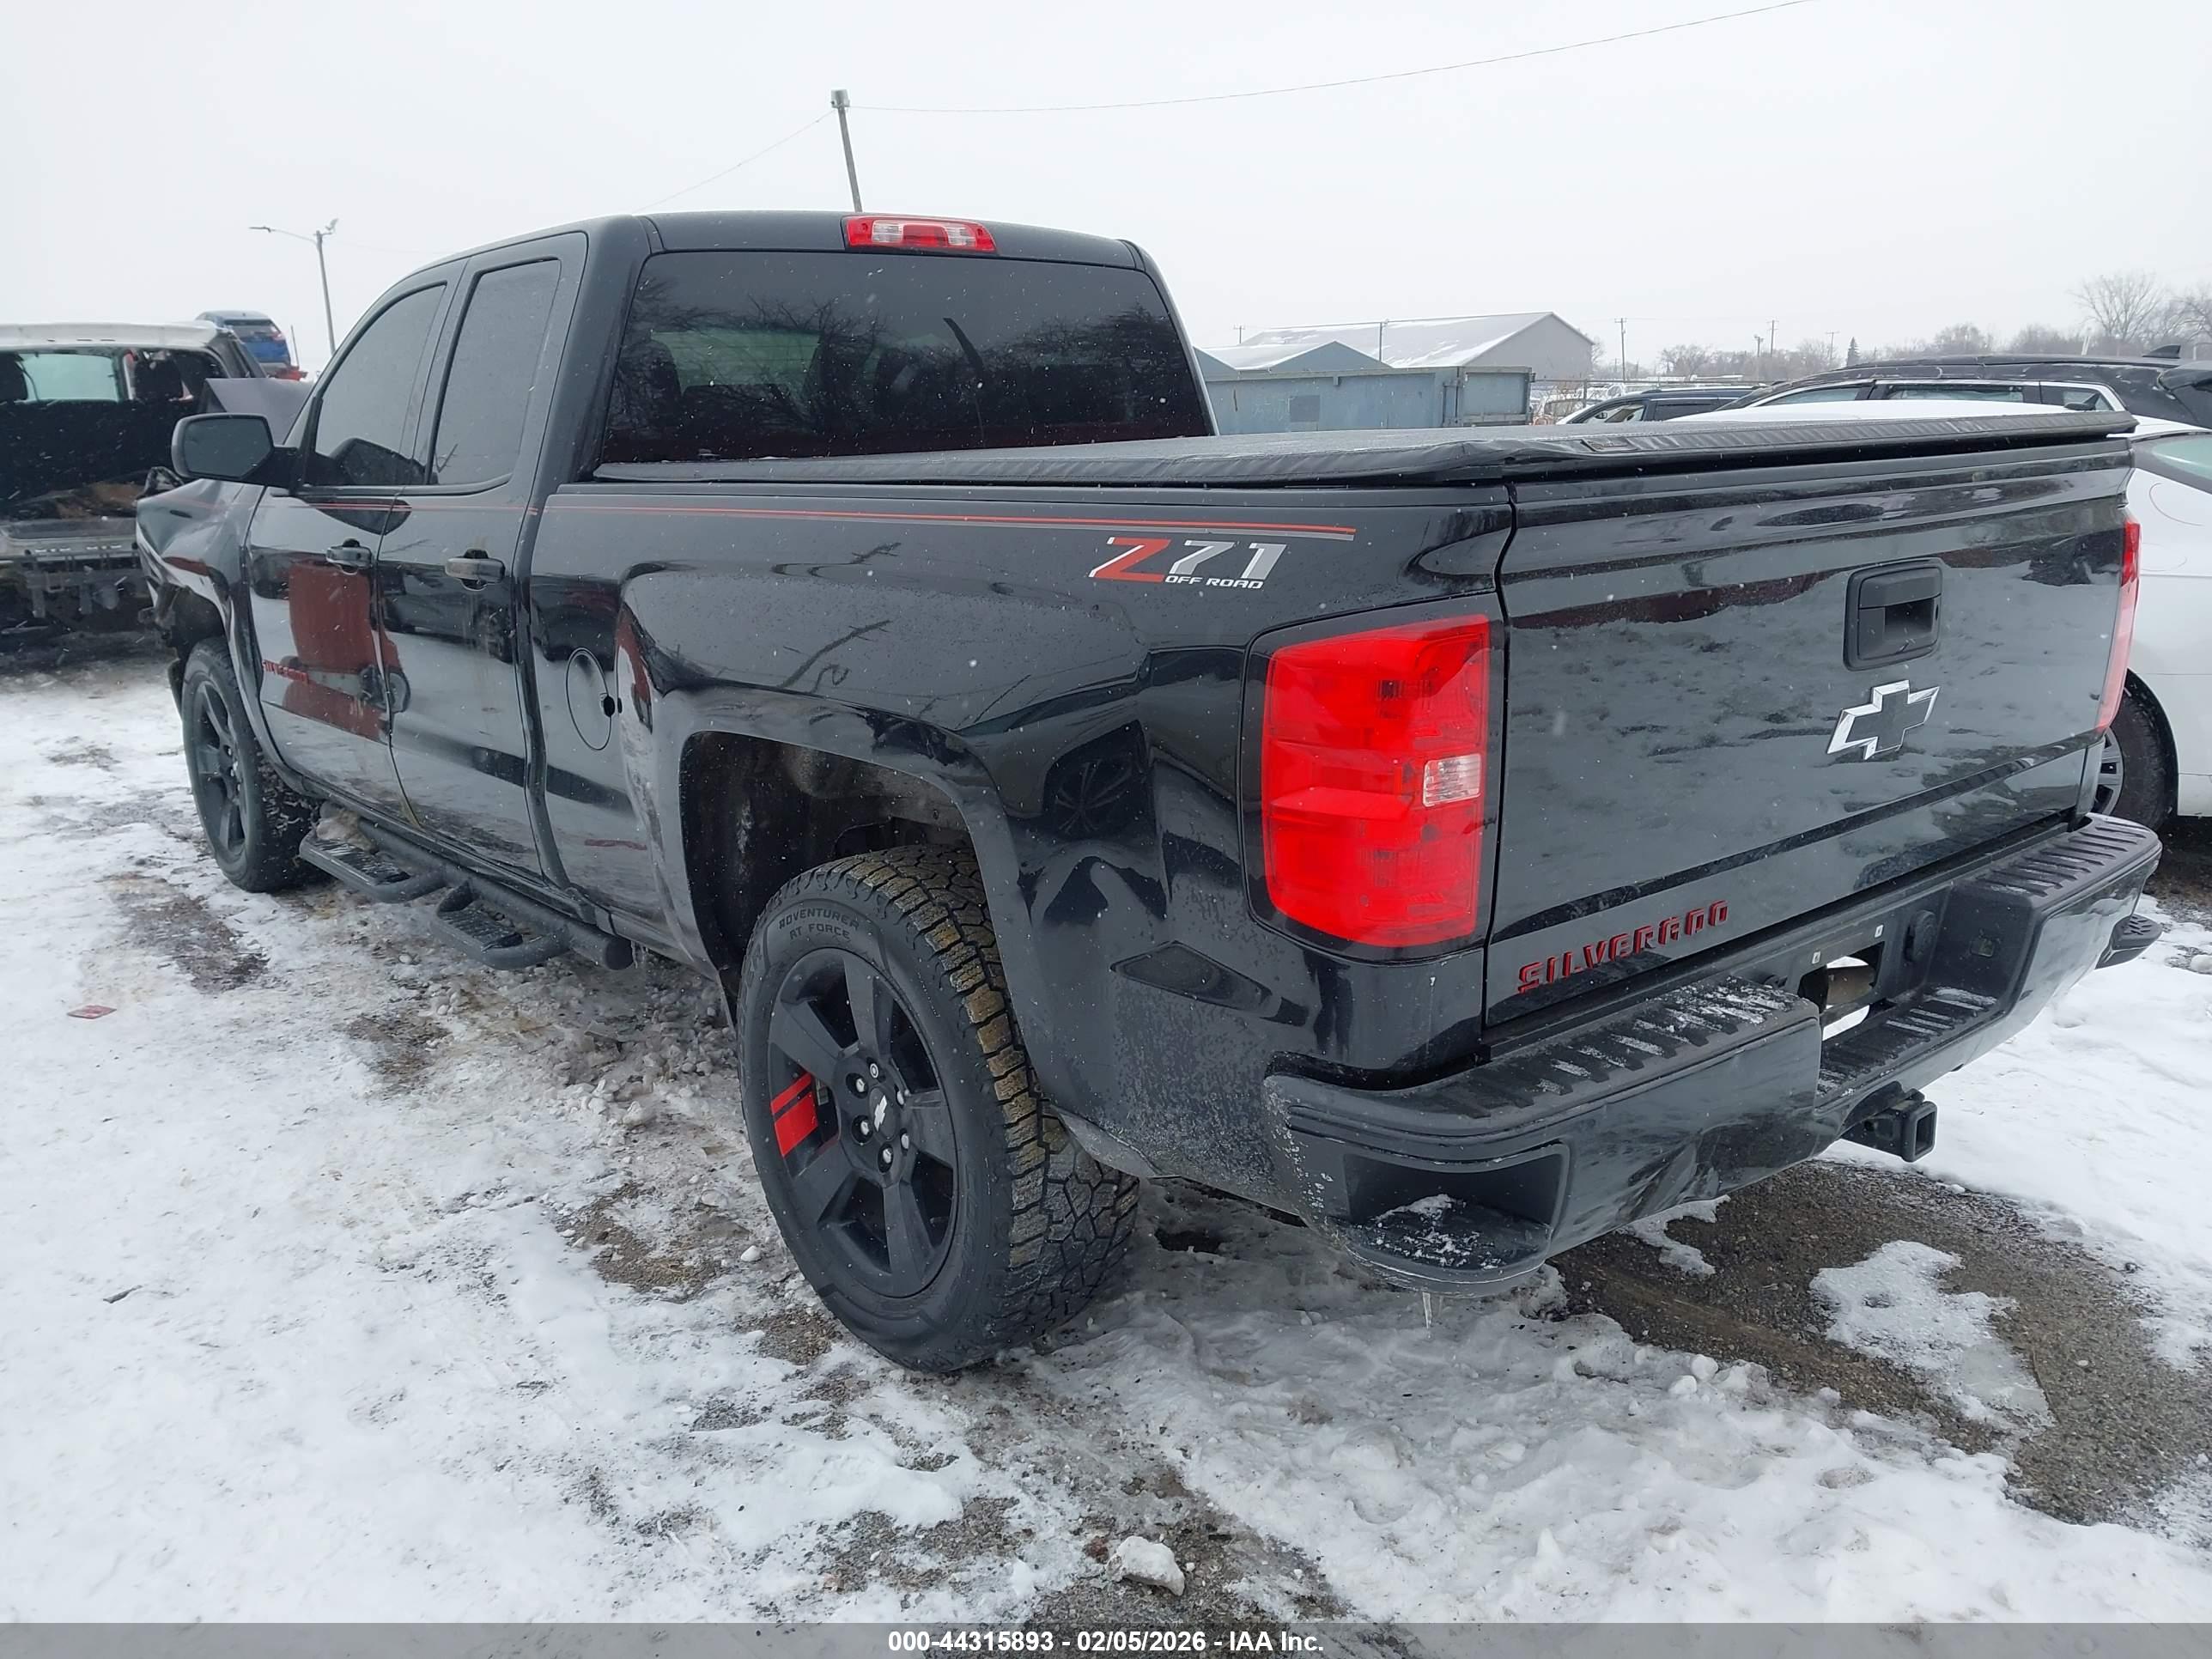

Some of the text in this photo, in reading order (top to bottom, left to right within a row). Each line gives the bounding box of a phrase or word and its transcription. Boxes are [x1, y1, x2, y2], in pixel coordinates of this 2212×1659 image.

[1088, 537, 1287, 582] Z71
[1164, 575, 1264, 589] OFF ROAD
[778, 908, 860, 930] ADVENTURER
[808, 923, 850, 939] FORCE
[1518, 900, 1729, 994] SILVERADO
